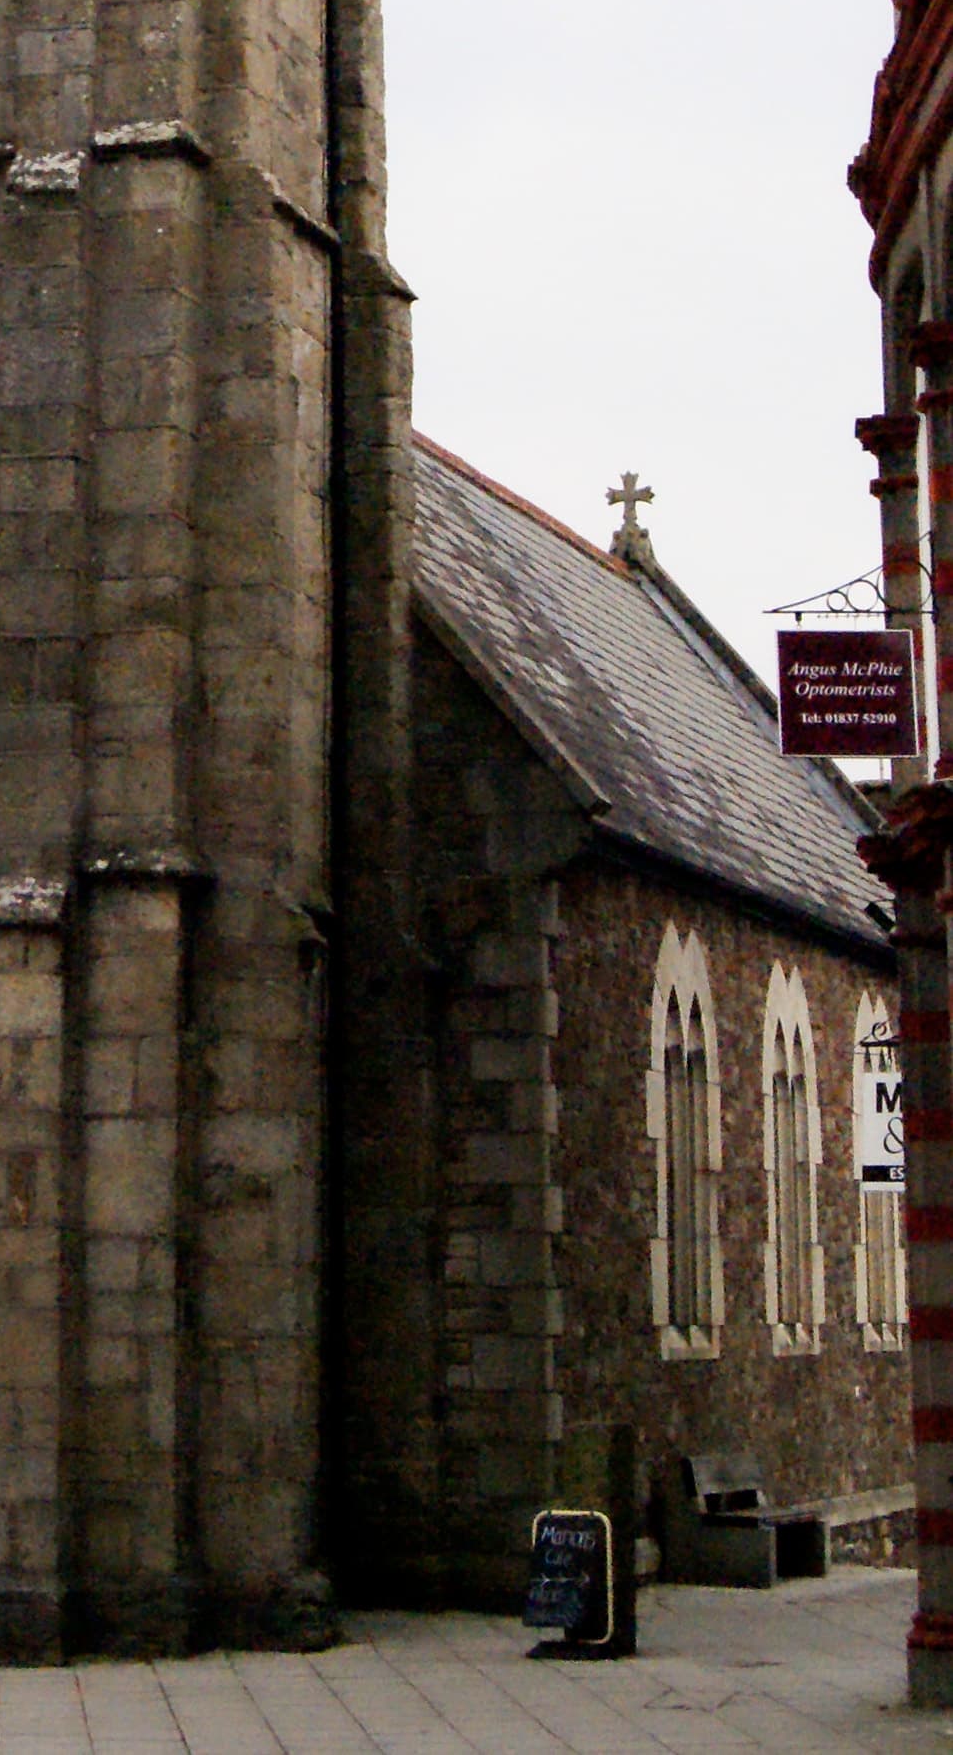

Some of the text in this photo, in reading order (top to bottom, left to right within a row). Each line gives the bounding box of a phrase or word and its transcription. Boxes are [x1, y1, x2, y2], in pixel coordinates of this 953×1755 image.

[788, 662, 903, 680] Angus McPhie
[796, 681, 896, 699] Optometrists
[801, 712, 897, 724] Tel: 01837 52910
